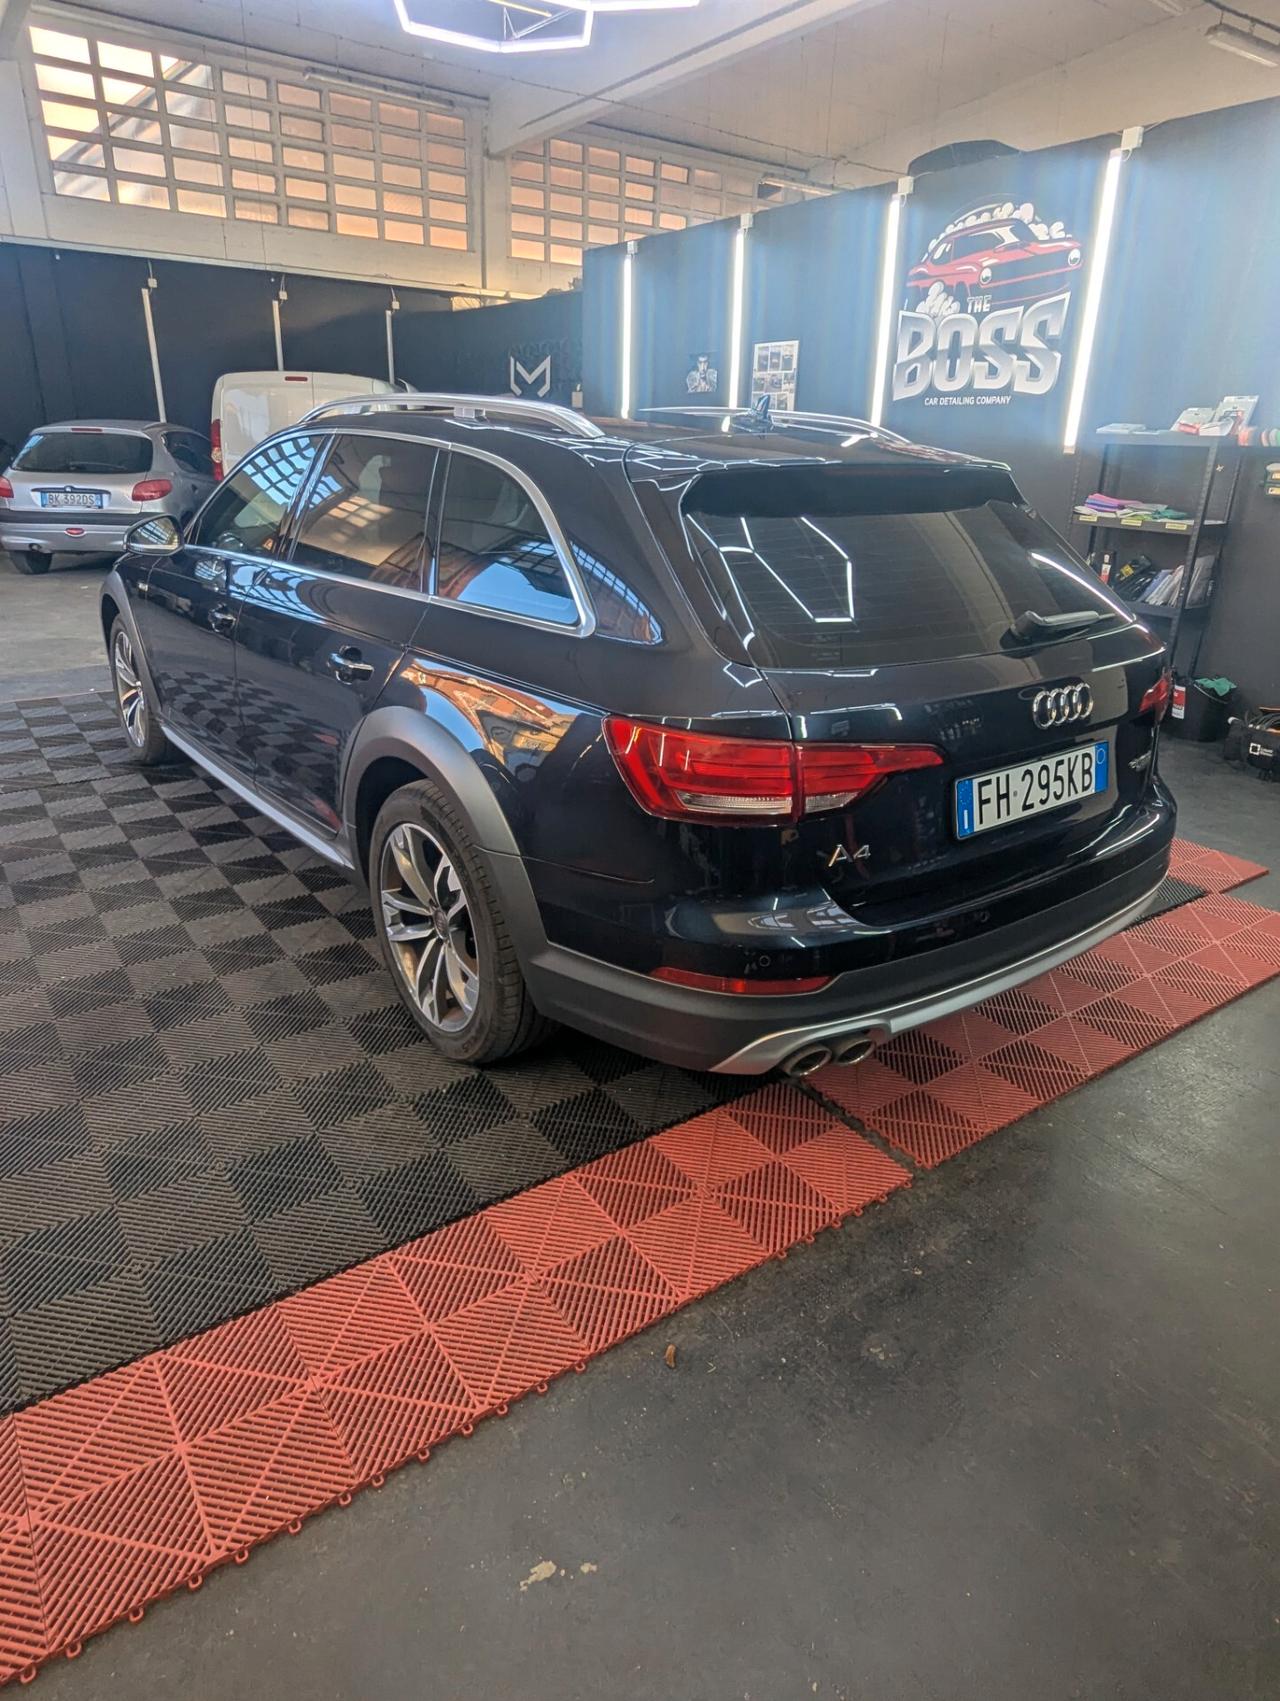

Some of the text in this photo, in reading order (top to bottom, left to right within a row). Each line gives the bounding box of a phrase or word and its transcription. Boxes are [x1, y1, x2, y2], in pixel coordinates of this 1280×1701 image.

[967, 295, 992, 313] THE
[893, 291, 1070, 401] BOSS
[924, 395, 1012, 406] CAR DETAILING COMPANY
[977, 779, 1010, 825] FH
[1020, 752, 1094, 812] 295KB
[828, 844, 871, 867] A4
